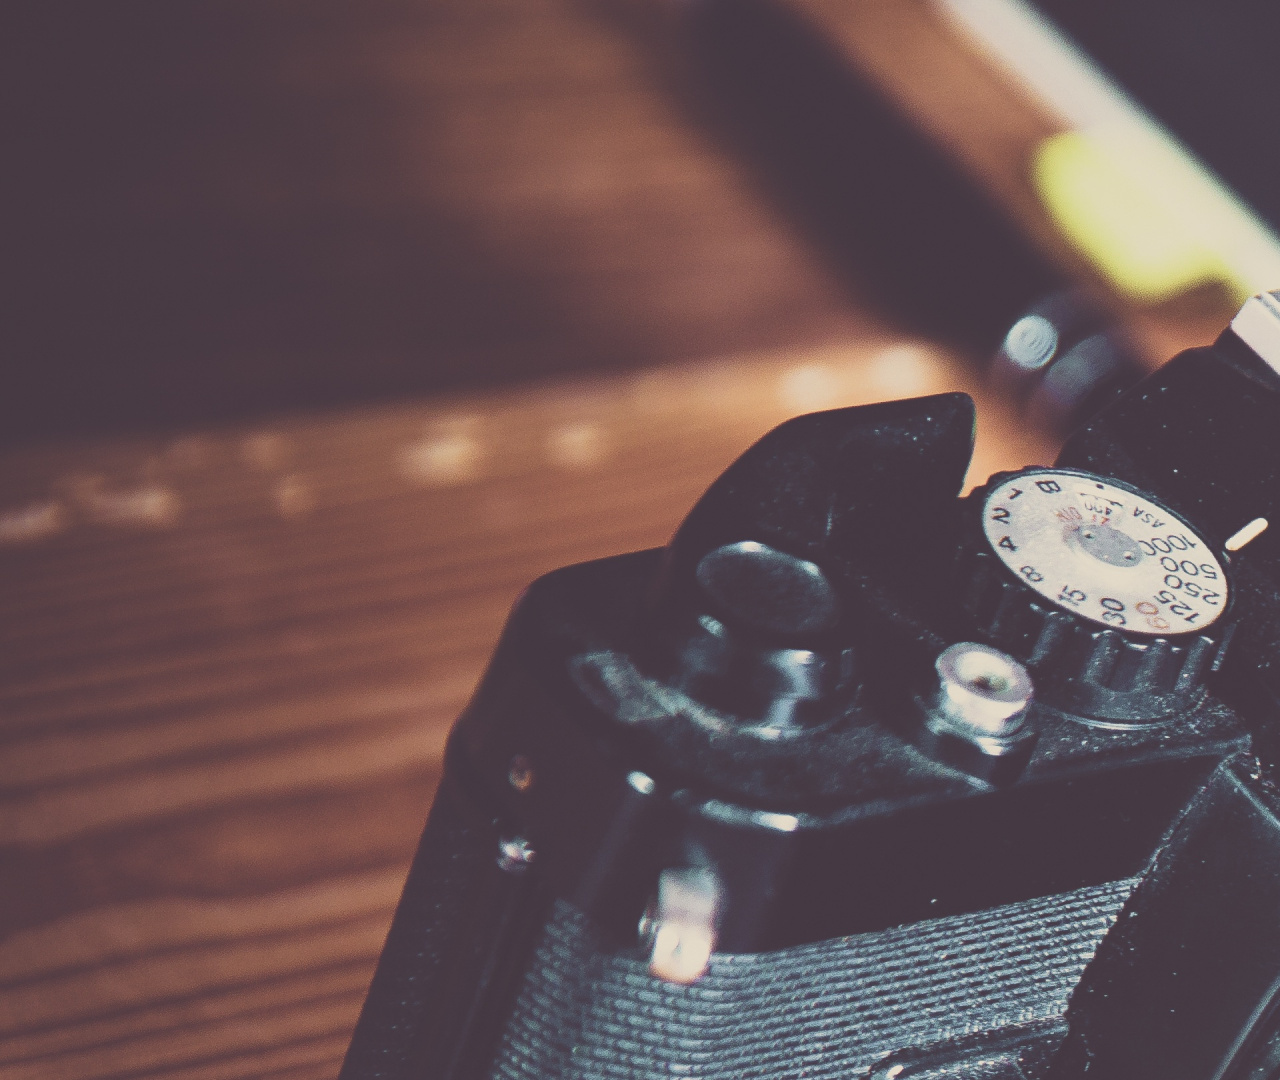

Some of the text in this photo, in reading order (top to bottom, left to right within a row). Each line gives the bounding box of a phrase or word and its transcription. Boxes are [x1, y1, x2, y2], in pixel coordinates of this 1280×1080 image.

[1008, 487, 1023, 501] 1
[1035, 480, 1061, 494] B
[991, 506, 1011, 525] 2
[1133, 505, 1166, 529] ASA
[998, 535, 1018, 552] 4
[1020, 565, 1044, 583] 8
[1160, 556, 1218, 580] 500
[1057, 584, 1087, 606] 15
[1163, 574, 1220, 606] 250
[1100, 597, 1127, 626] 30
[1135, 601, 1170, 630] 60
[1153, 589, 1200, 623] 125
